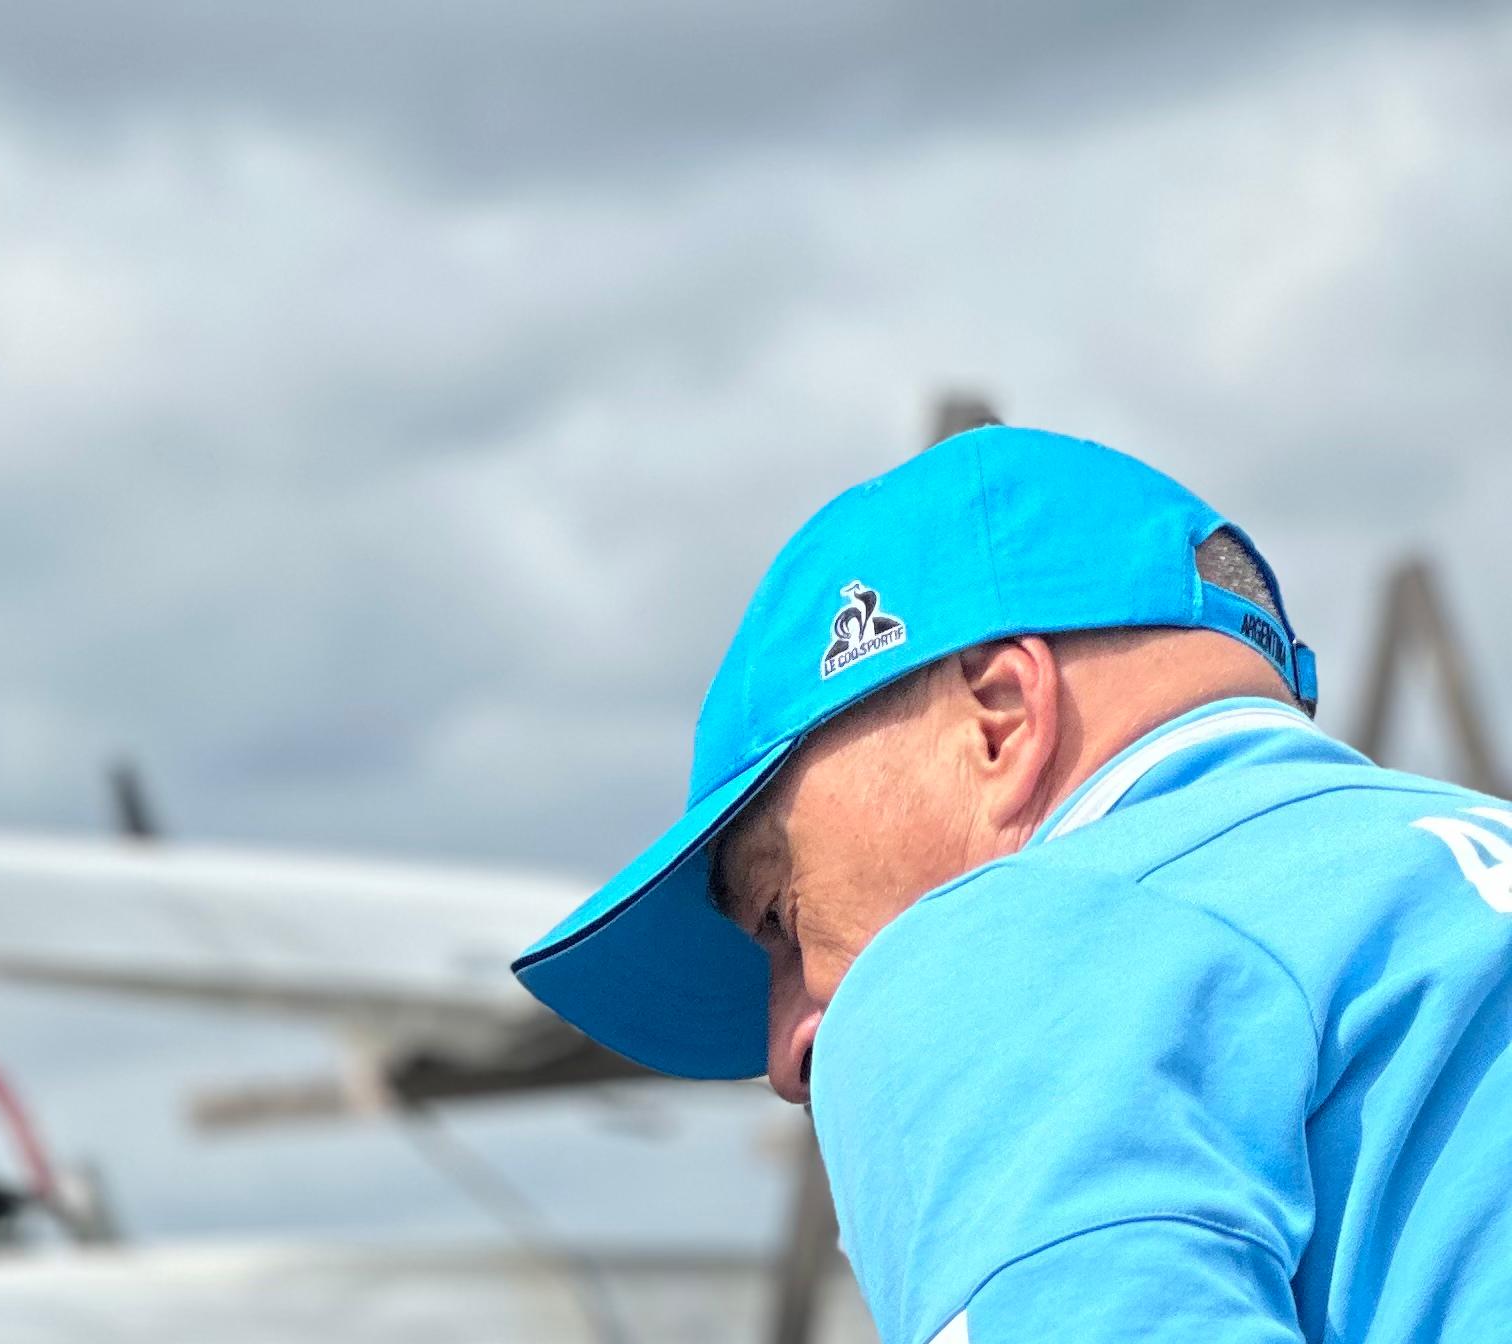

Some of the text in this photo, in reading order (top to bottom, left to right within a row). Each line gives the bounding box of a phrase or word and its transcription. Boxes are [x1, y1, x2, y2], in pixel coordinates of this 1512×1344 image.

[824, 626, 904, 676] LE COQ SPORTIF
